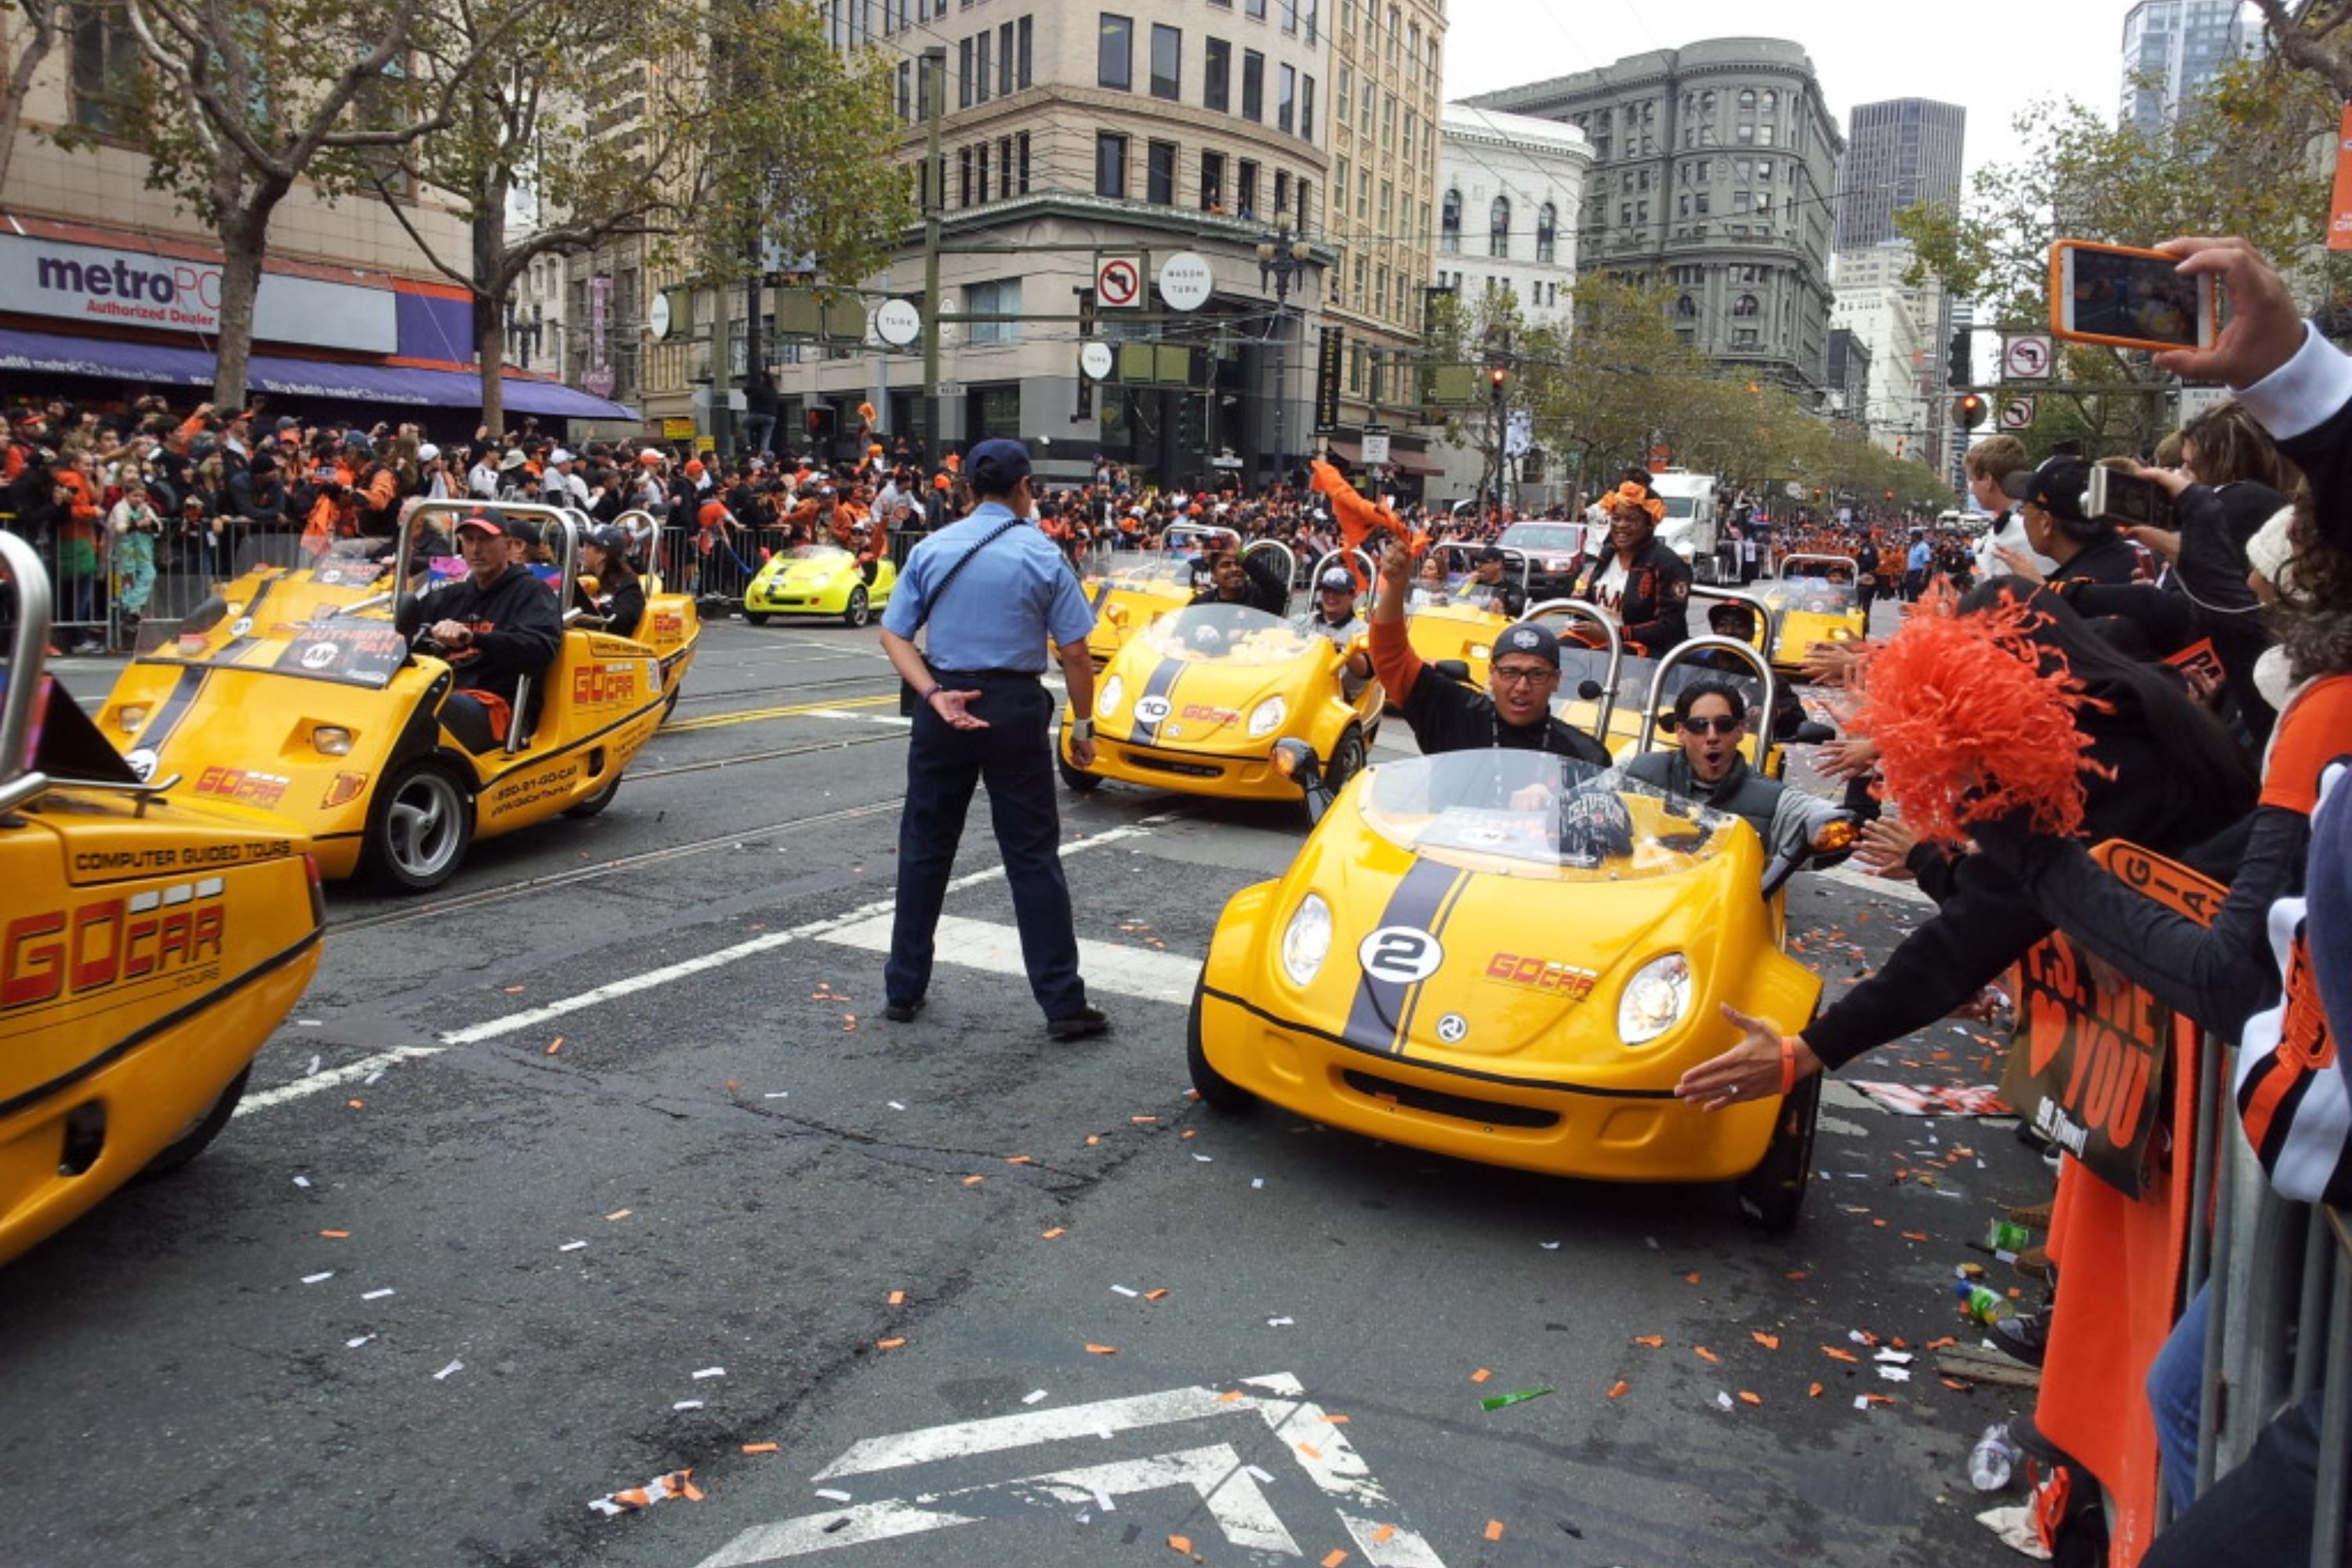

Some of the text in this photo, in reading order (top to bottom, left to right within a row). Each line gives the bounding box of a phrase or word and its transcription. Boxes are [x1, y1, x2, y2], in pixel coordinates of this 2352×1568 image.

[38, 257, 222, 310] metroPC
[86, 299, 215, 326] Authorized Dealer
[886, 317, 913, 328] TURK
[1142, 702, 1168, 716] 10
[76, 839, 292, 871] COMPUTER GUIDED TOURS
[1371, 932, 1427, 975] 2
[175, 967, 220, 989] TOURS
[2063, 1012, 2151, 1149] YOU
